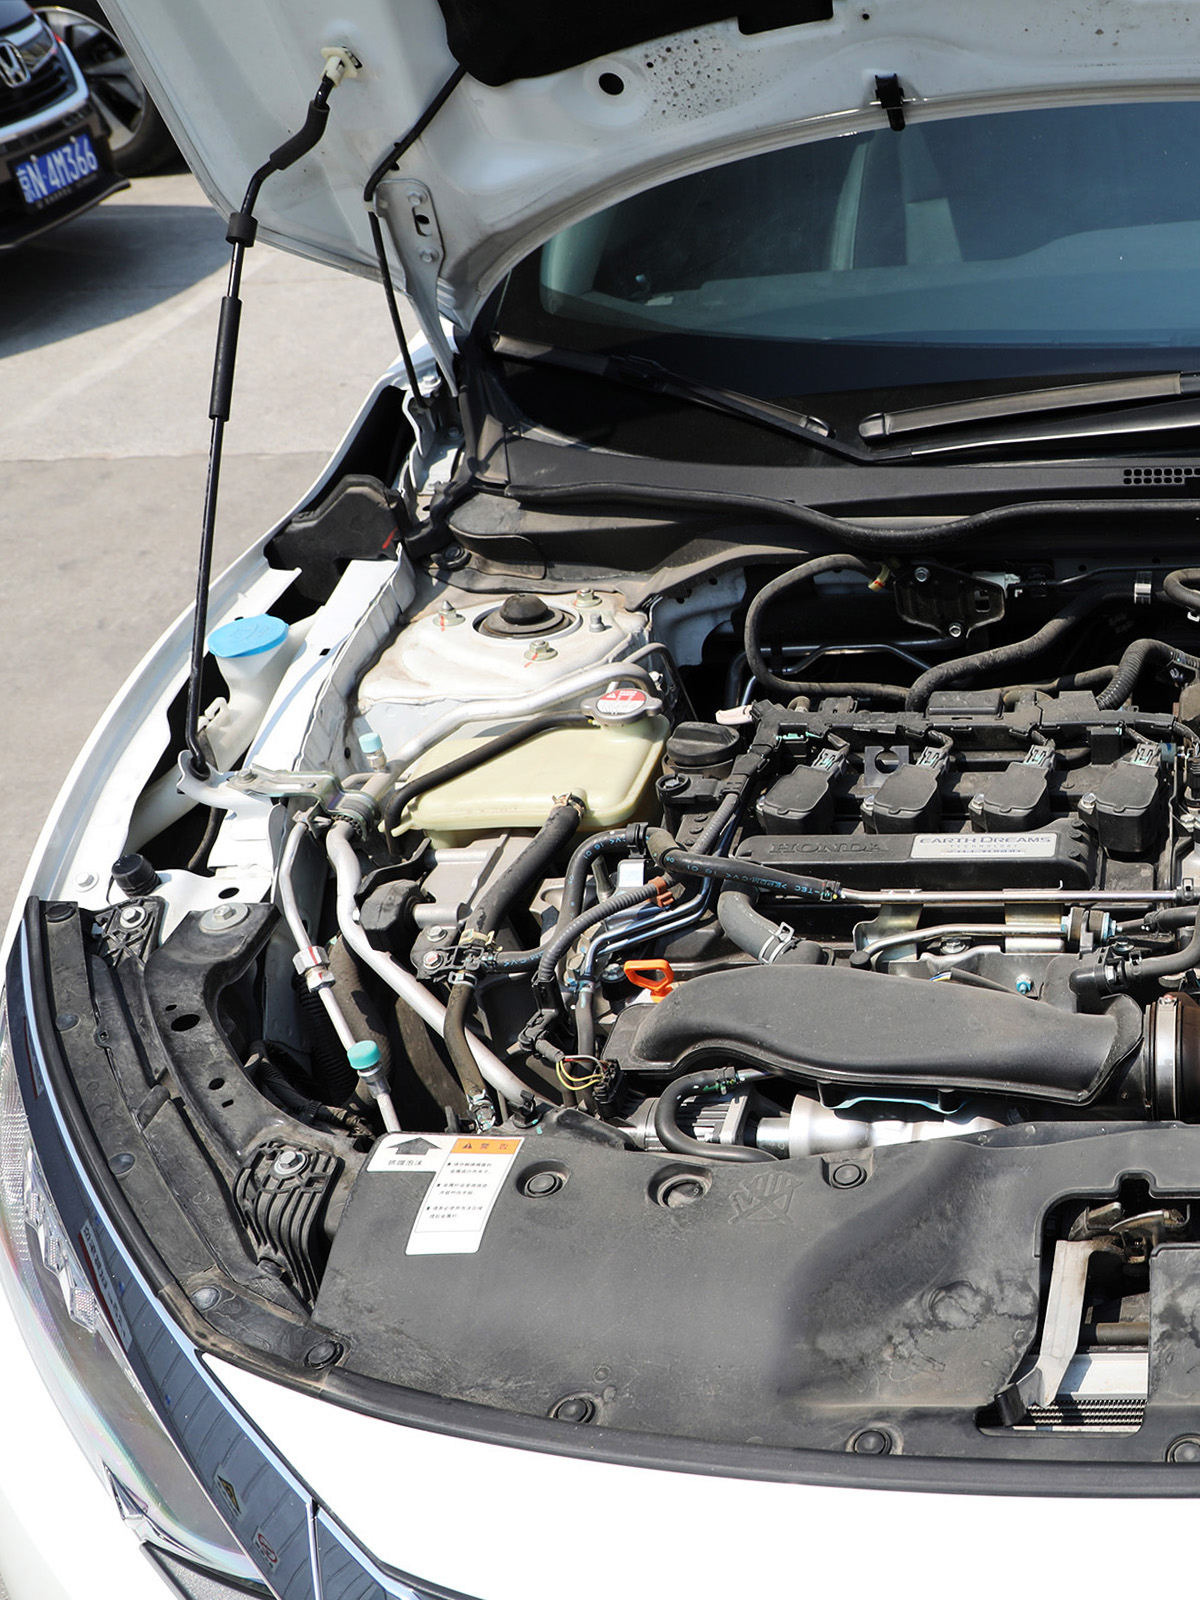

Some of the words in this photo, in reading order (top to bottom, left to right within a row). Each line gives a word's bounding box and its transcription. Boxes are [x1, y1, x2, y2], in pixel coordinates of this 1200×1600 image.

[919, 836, 977, 844] EARTH
[979, 835, 1051, 844] DREAMS
[769, 843, 892, 854] HONDA
